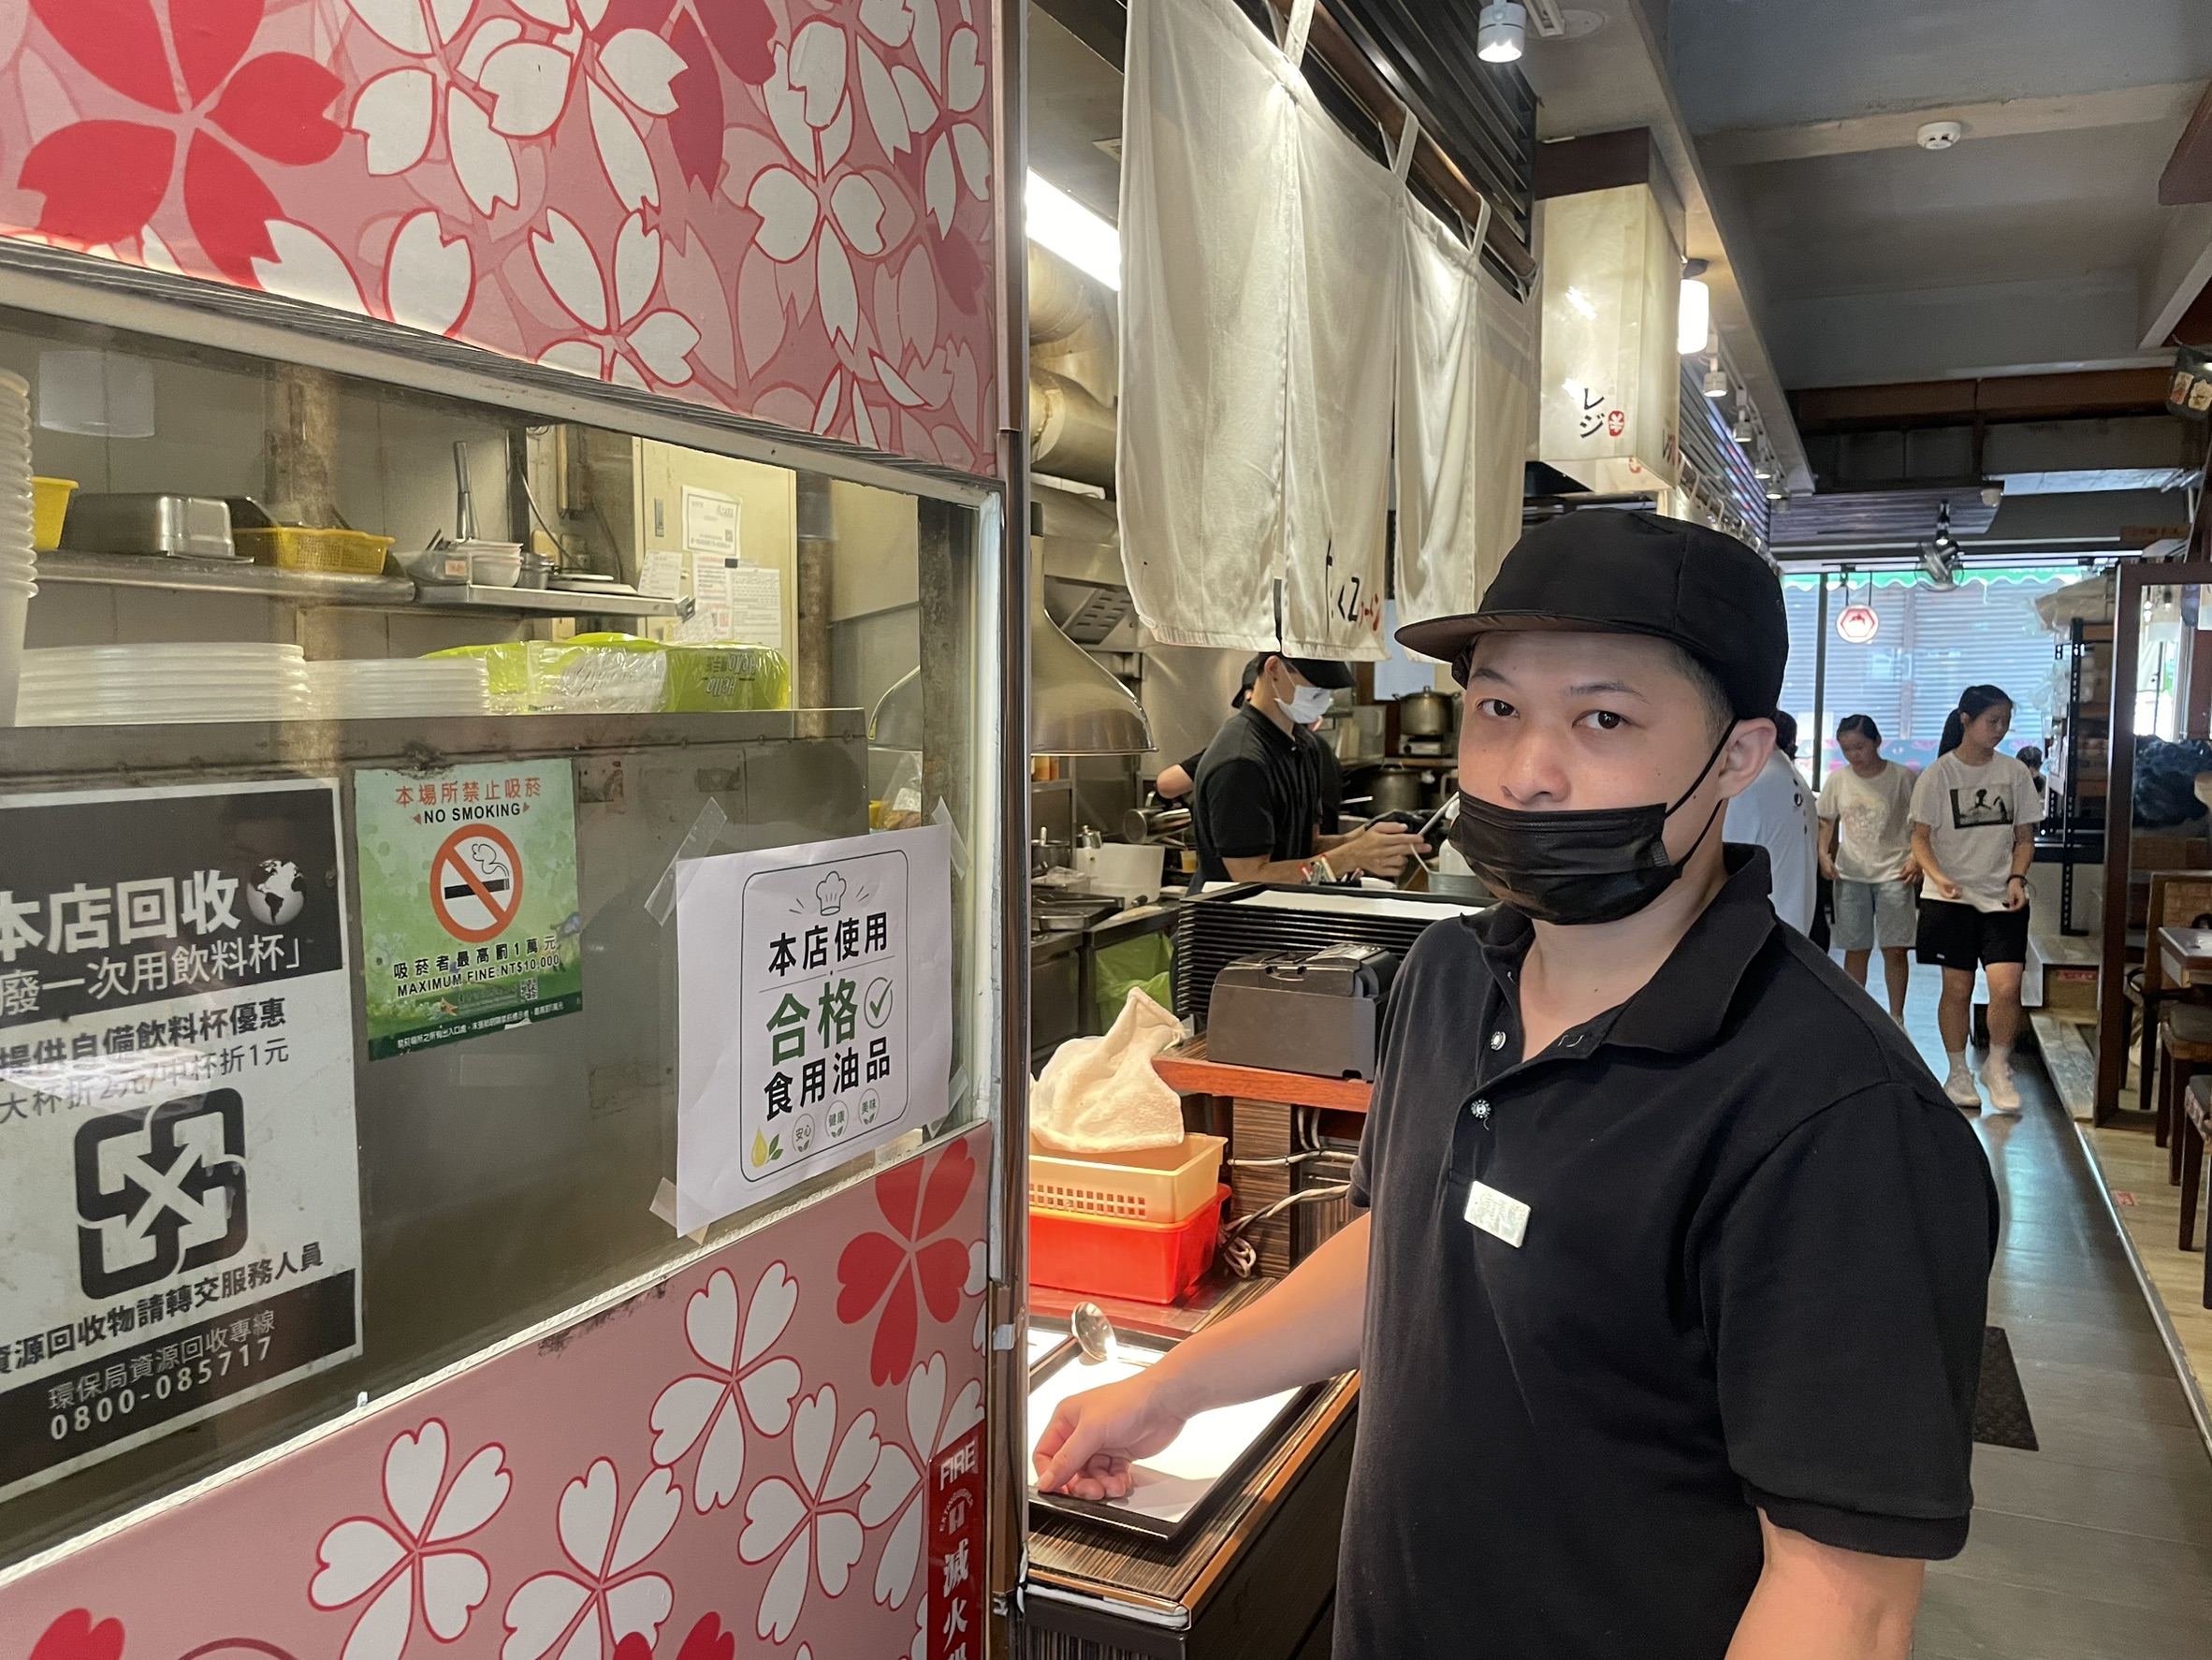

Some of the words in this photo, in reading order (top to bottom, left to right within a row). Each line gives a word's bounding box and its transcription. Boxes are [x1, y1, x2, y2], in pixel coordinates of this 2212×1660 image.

[1579, 387, 1606, 439] レジ
[395, 777, 541, 808] 本場所禁止吸菸
[424, 809, 446, 823] NO
[452, 803, 521, 821] SMOKING
[0, 869, 242, 962] 本店回收
[768, 911, 887, 977] 本店使用
[397, 973, 462, 997] MAXIMUM
[765, 978, 859, 1067] 合格
[764, 1037, 891, 1122] 食用油品
[862, 1099, 877, 1114] 美味
[795, 1125, 812, 1142] 安心
[49, 1311, 275, 1410] 環保局資源回收專線
[51, 1336, 271, 1440] 0800-085717
[940, 1439, 976, 1491] FIRE
